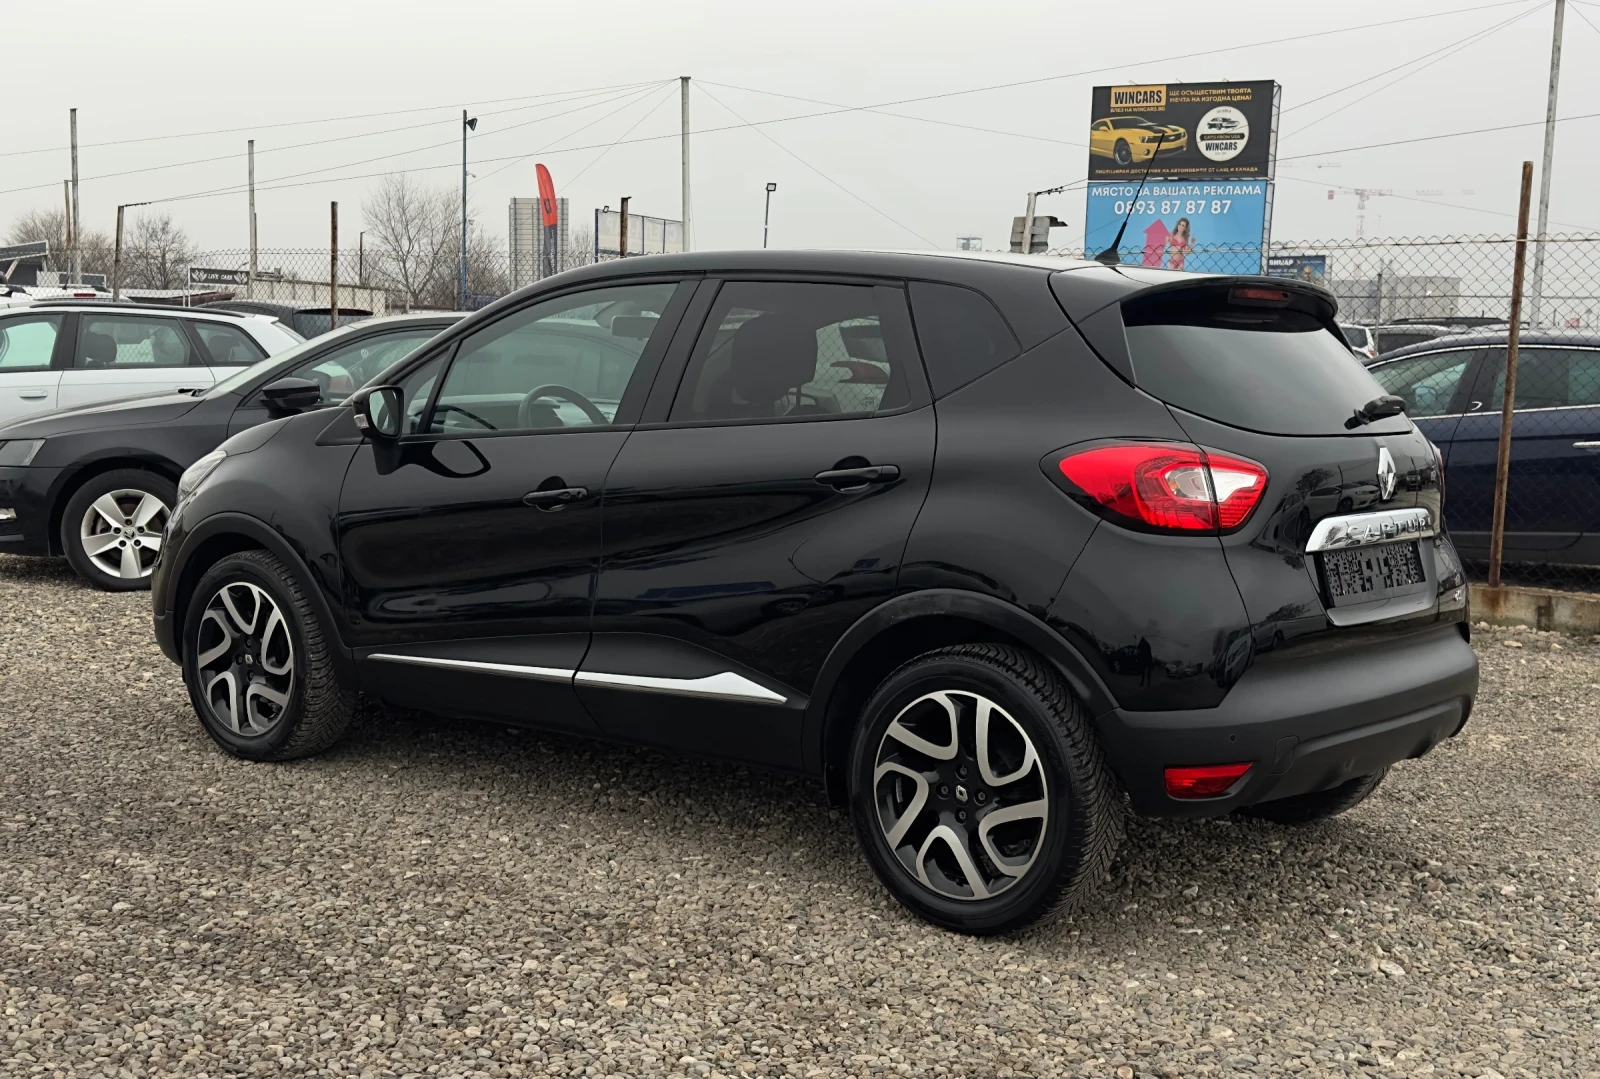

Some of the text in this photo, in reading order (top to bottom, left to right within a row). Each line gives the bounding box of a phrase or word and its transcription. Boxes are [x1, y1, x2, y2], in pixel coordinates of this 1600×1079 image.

[1114, 90, 1162, 104] WINCARS
[1205, 141, 1238, 151] WINCARS
[1092, 187, 1133, 196] МЯСТО
[1153, 186, 1200, 196] ВАШАТА
[1204, 185, 1261, 195] РЕКЛАМА
[1114, 200, 1231, 215] 0893 87 87 87
